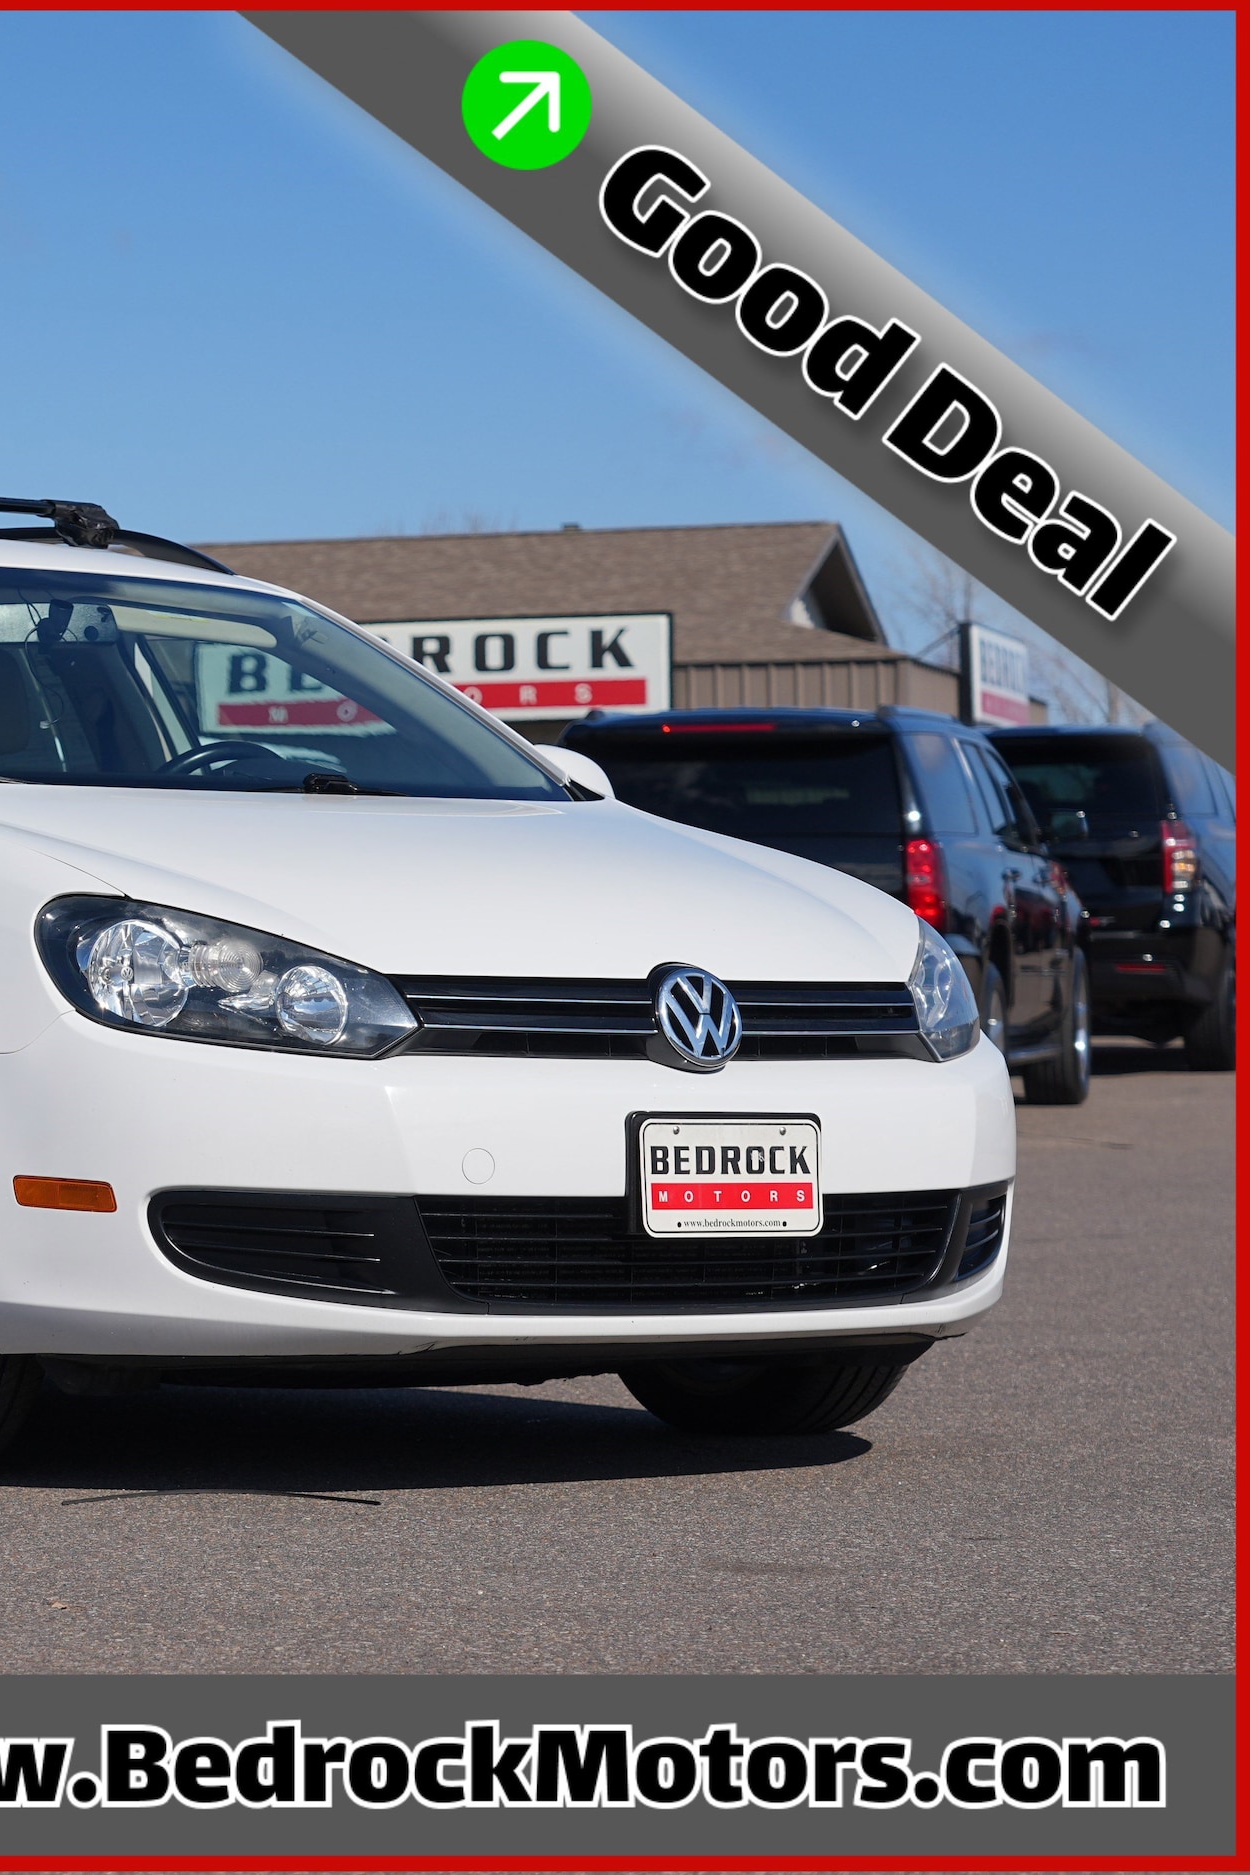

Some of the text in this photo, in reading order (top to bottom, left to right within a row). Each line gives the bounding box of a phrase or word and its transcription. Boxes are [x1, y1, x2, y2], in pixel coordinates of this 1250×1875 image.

[228, 627, 635, 694] BROCK
[268, 682, 593, 724] MOORS
[650, 1145, 811, 1175] BEDROCK
[658, 1189, 806, 1203] MOTORS
[683, 1218, 781, 1228] www.bedrockmotors.com
